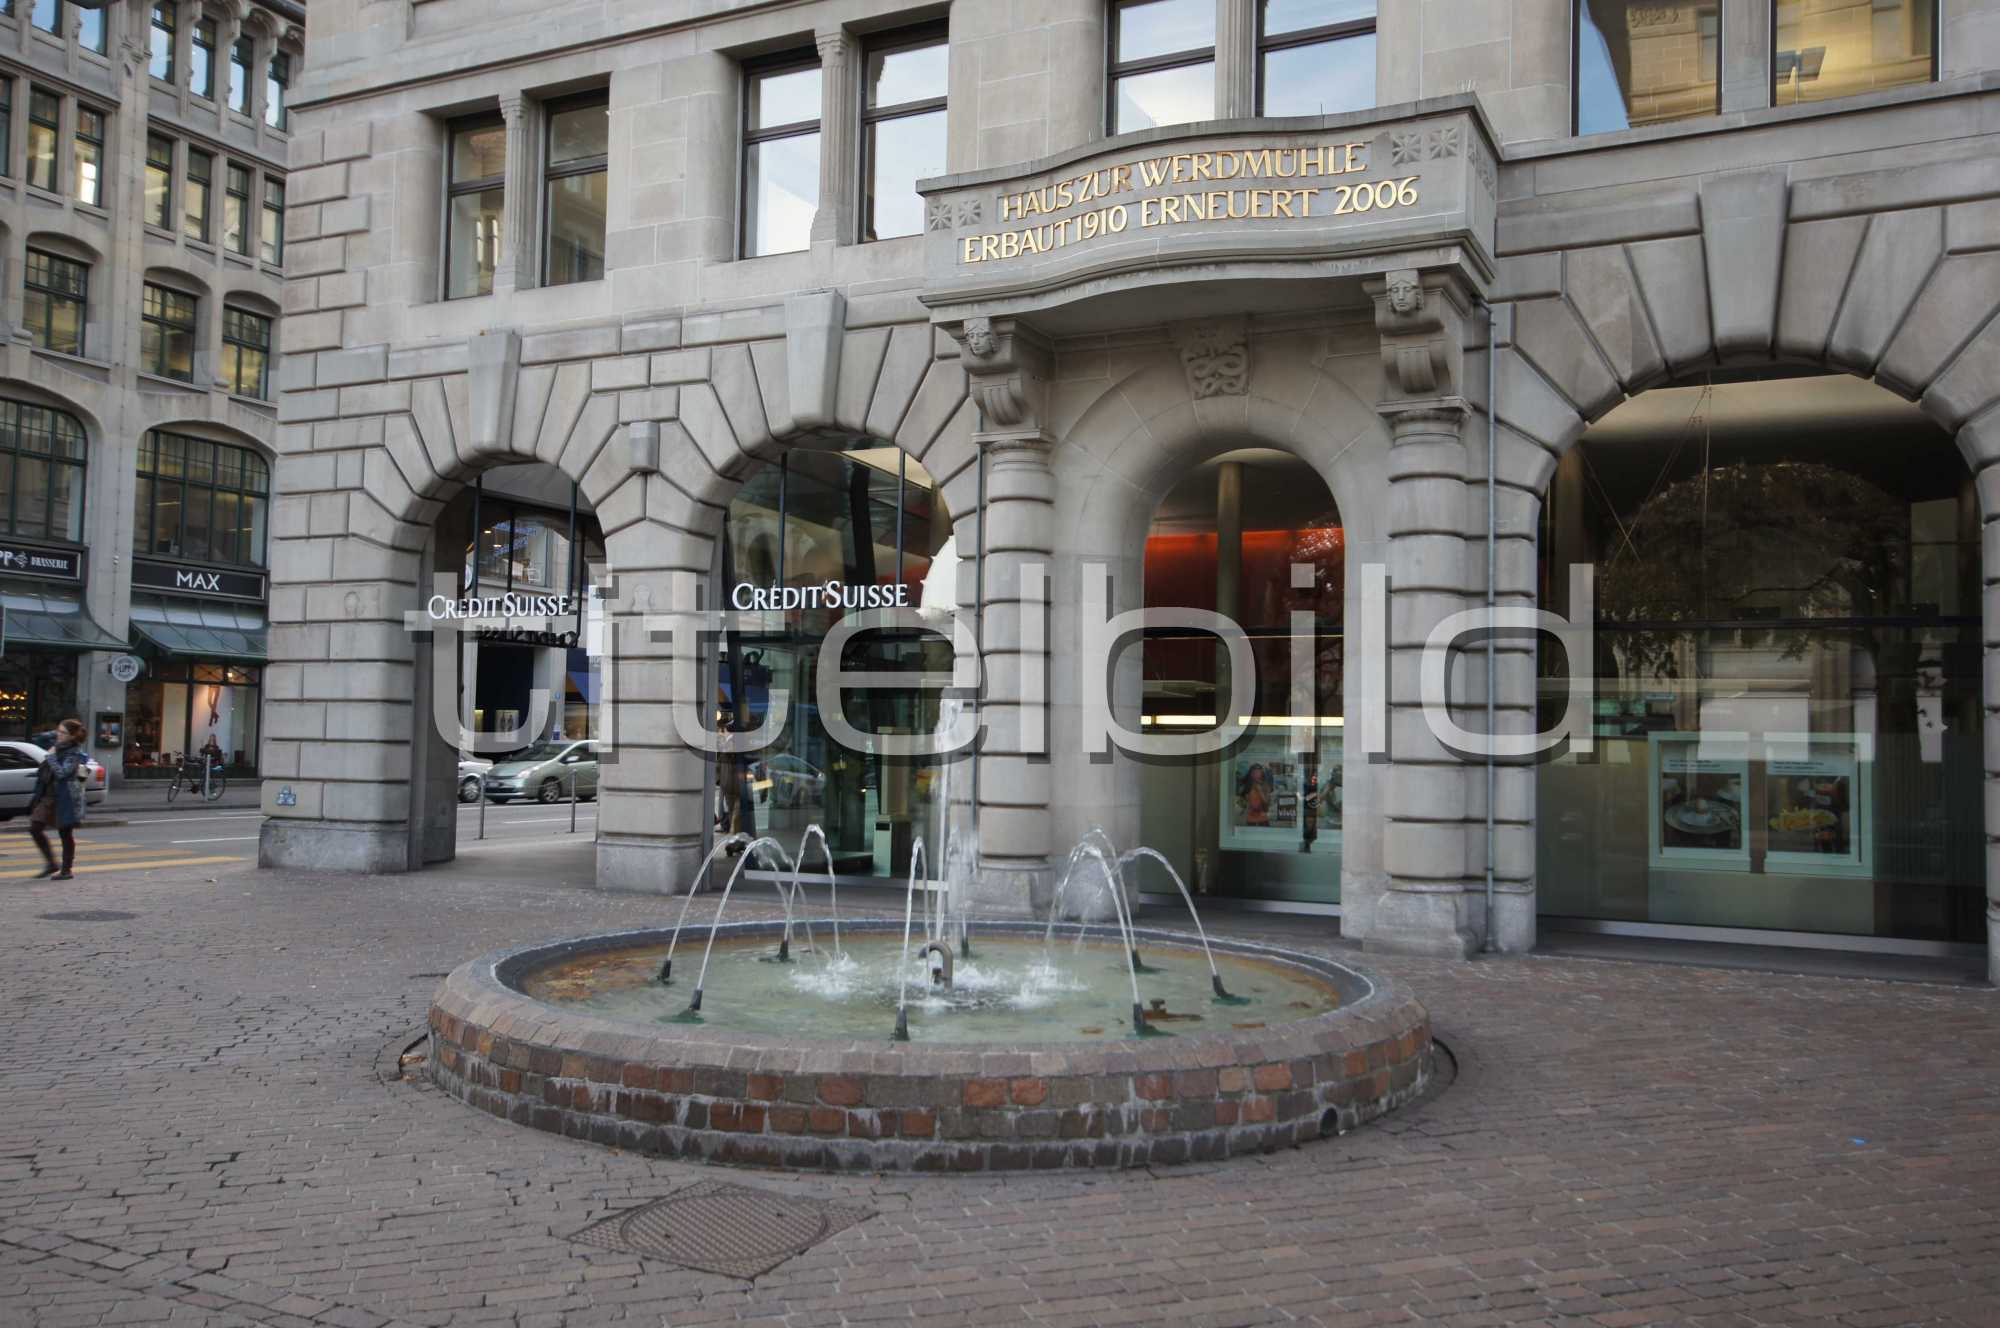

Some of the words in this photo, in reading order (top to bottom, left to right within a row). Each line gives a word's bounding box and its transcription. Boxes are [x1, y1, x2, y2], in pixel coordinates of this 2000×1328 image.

[1003, 181, 1074, 221] HAUS
[1078, 164, 1133, 203] ZUR
[1138, 142, 1368, 187] WERDMÜHLE
[963, 218, 1073, 264] ERBAUT
[1076, 204, 1129, 242] 1910
[1141, 188, 1320, 228] ERNEUERT
[1333, 175, 1420, 215] 2006
[176, 569, 220, 591] MAX
[731, 582, 823, 610] CREDIT
[825, 580, 908, 609] SUISSE
[427, 594, 500, 620] CREDIT
[502, 591, 569, 617] SUISSE
